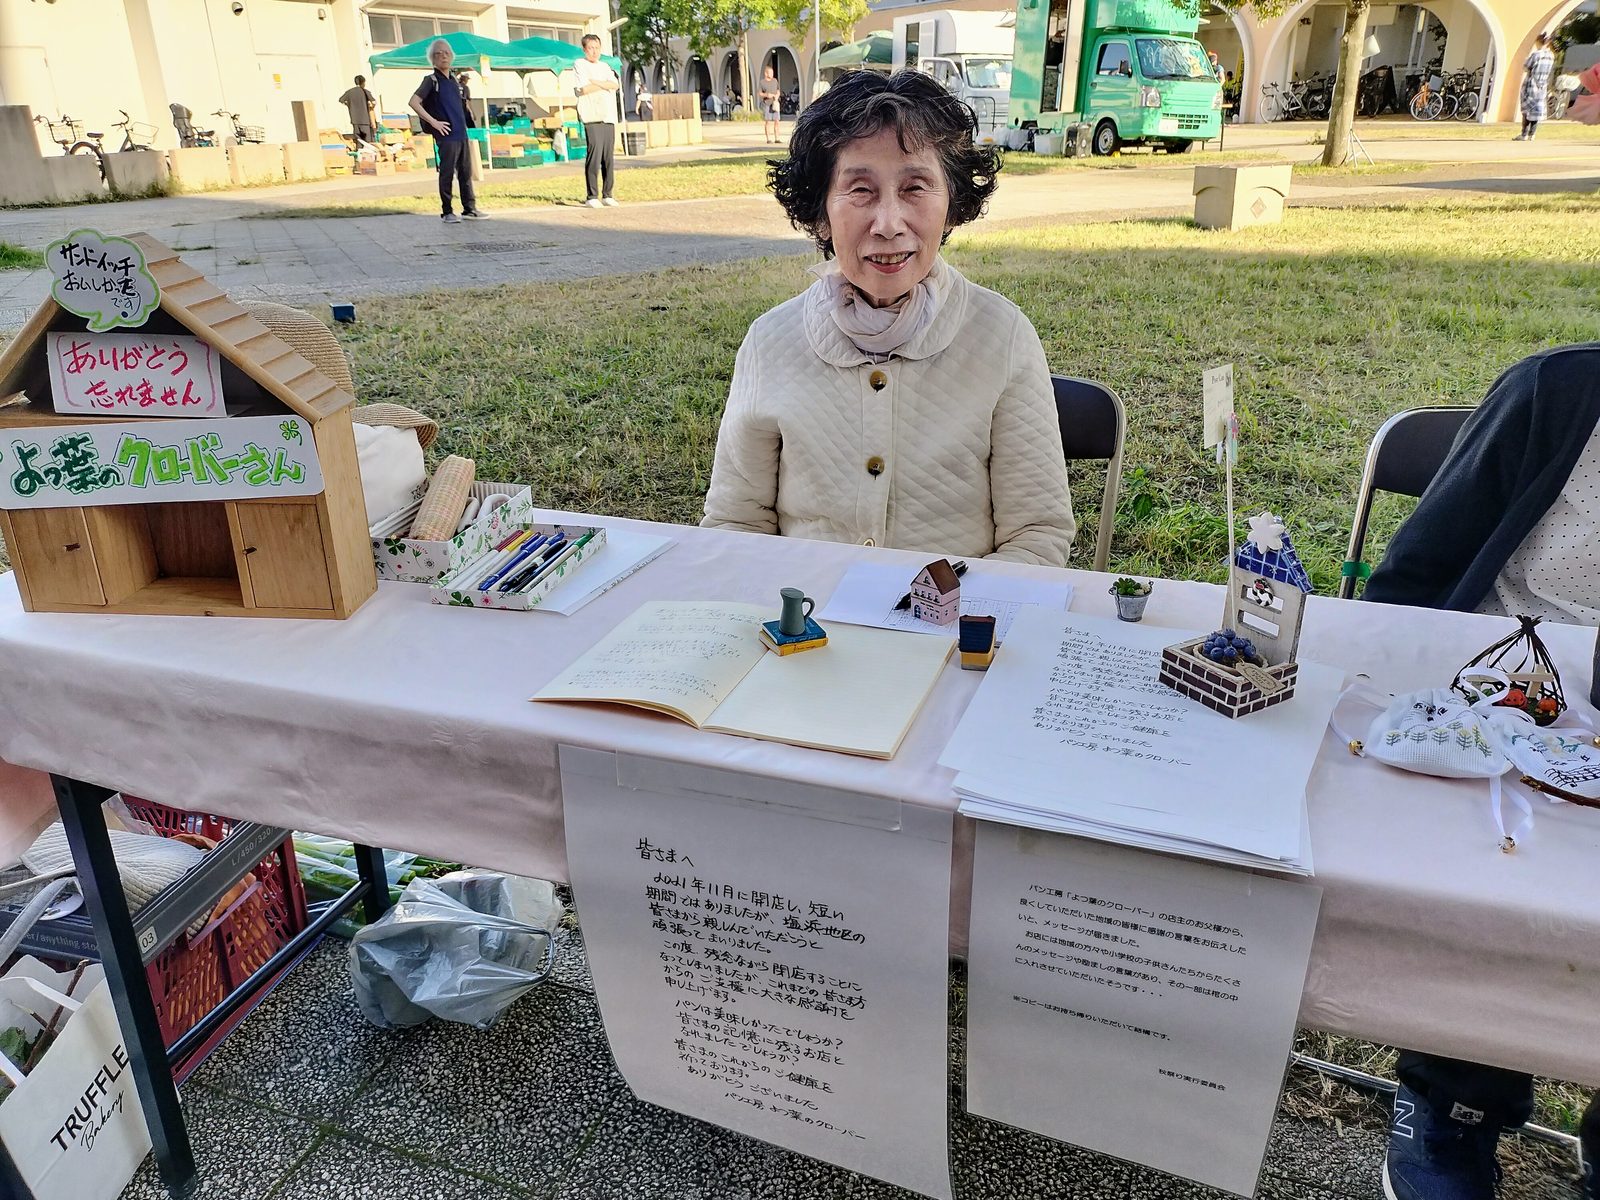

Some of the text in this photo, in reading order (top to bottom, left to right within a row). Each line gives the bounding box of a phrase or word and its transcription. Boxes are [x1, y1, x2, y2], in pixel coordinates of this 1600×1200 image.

[60, 243, 136, 276] サンドイッチ
[111, 297, 133, 310] です
[63, 341, 189, 376] ありがとう
[85, 378, 202, 409] 忘れません
[231, 826, 278, 866] L/450/320/
[635, 837, 695, 867] 皆さまへ
[22, 933, 79, 949] er/anything
[141, 932, 154, 949] 03
[50, 1044, 130, 1152] TRUFFLE
[80, 1089, 125, 1152] Bakery
